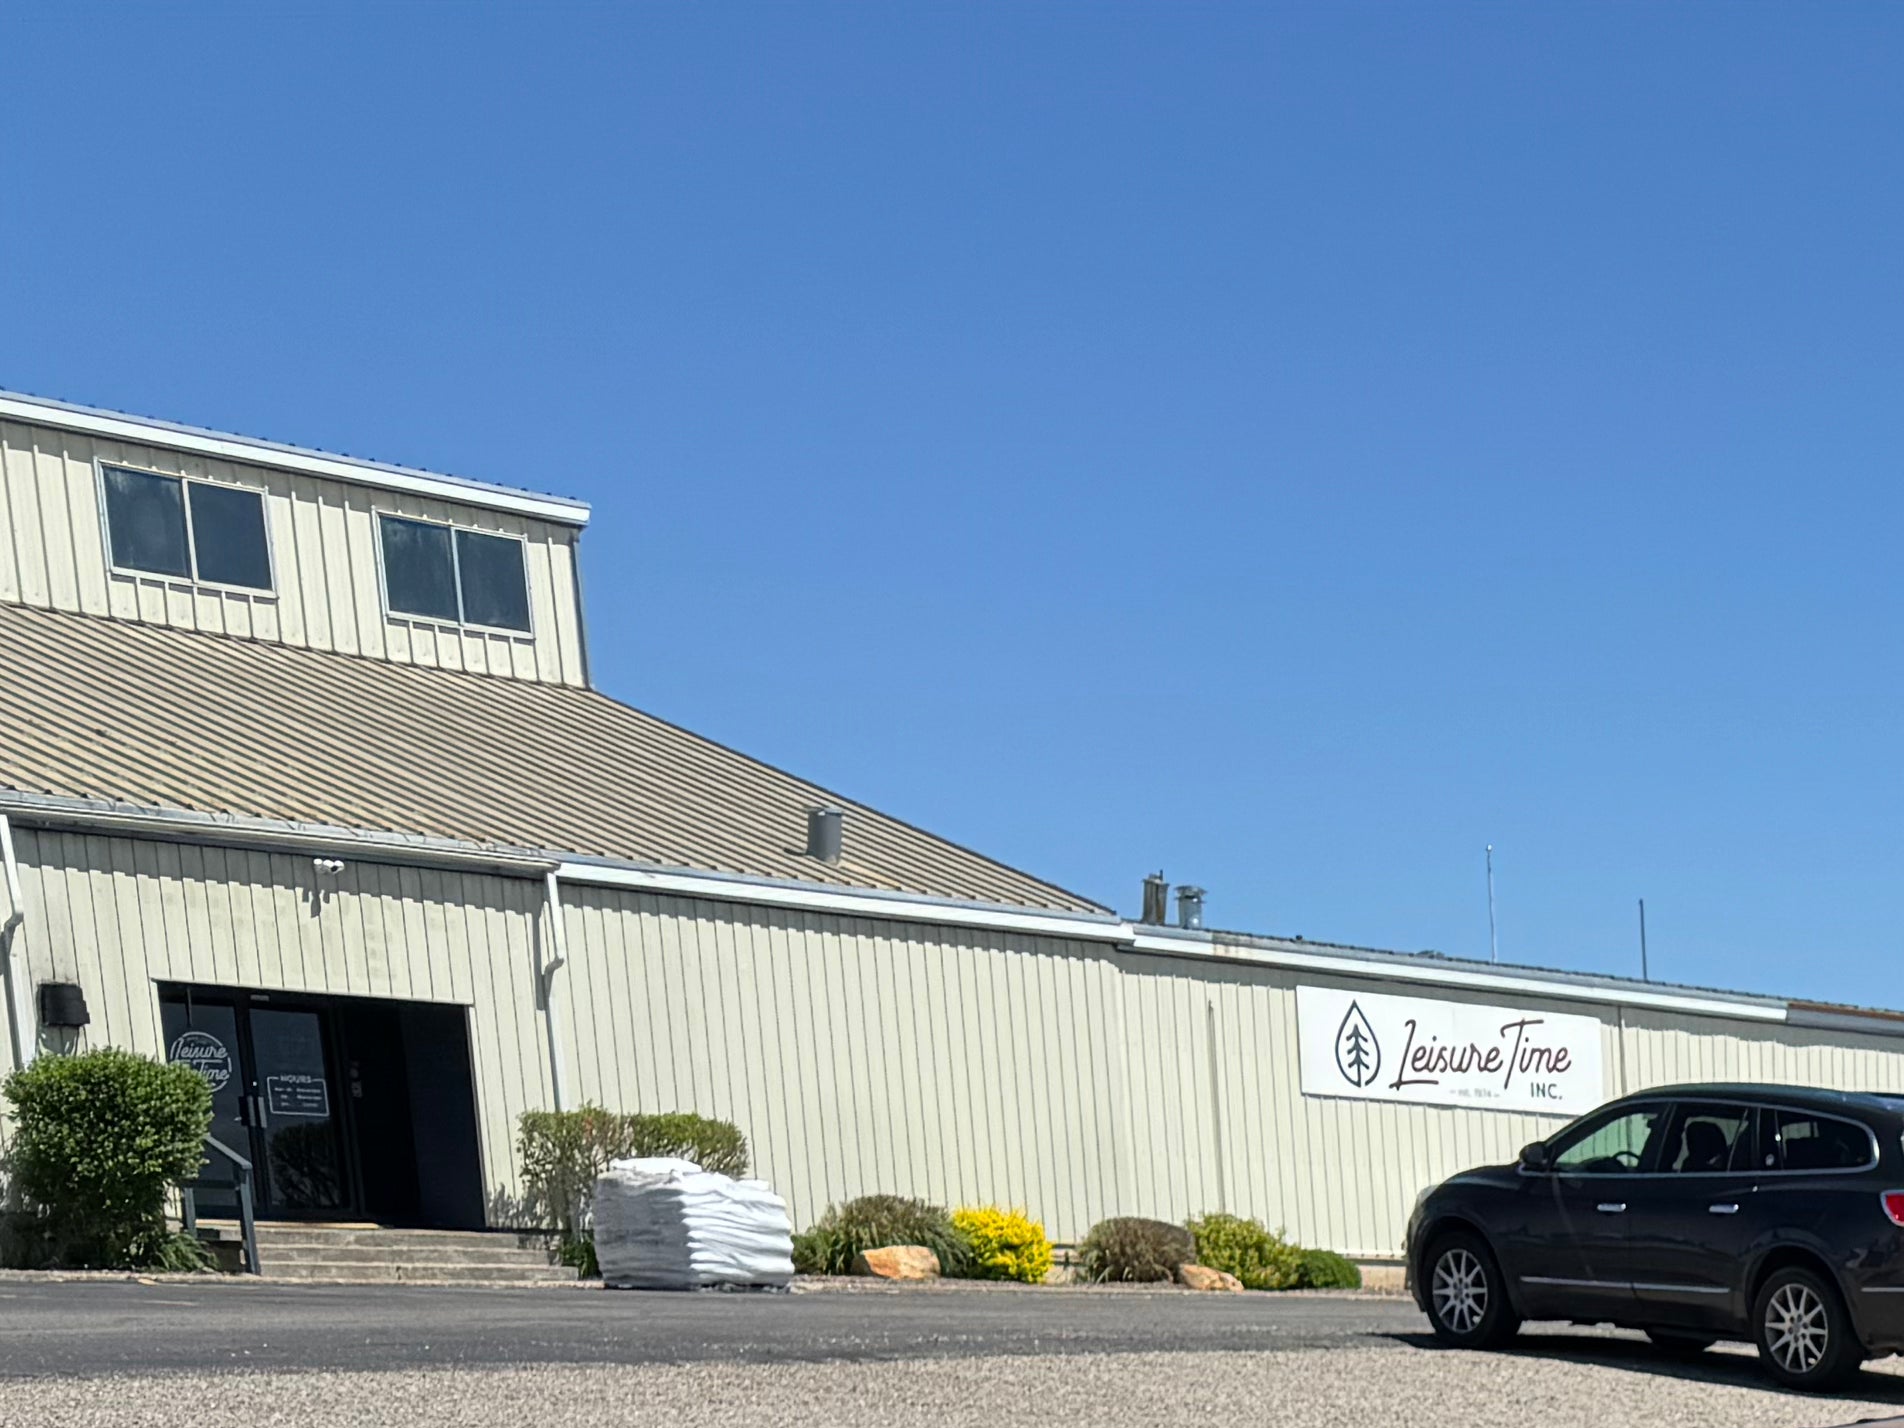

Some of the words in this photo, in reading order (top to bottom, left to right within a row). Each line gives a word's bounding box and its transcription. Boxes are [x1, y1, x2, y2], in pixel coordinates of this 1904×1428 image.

[1389, 1018, 1504, 1091] Leisure
[1499, 1017, 1572, 1090] Time
[1530, 1082, 1563, 1100] INC.
